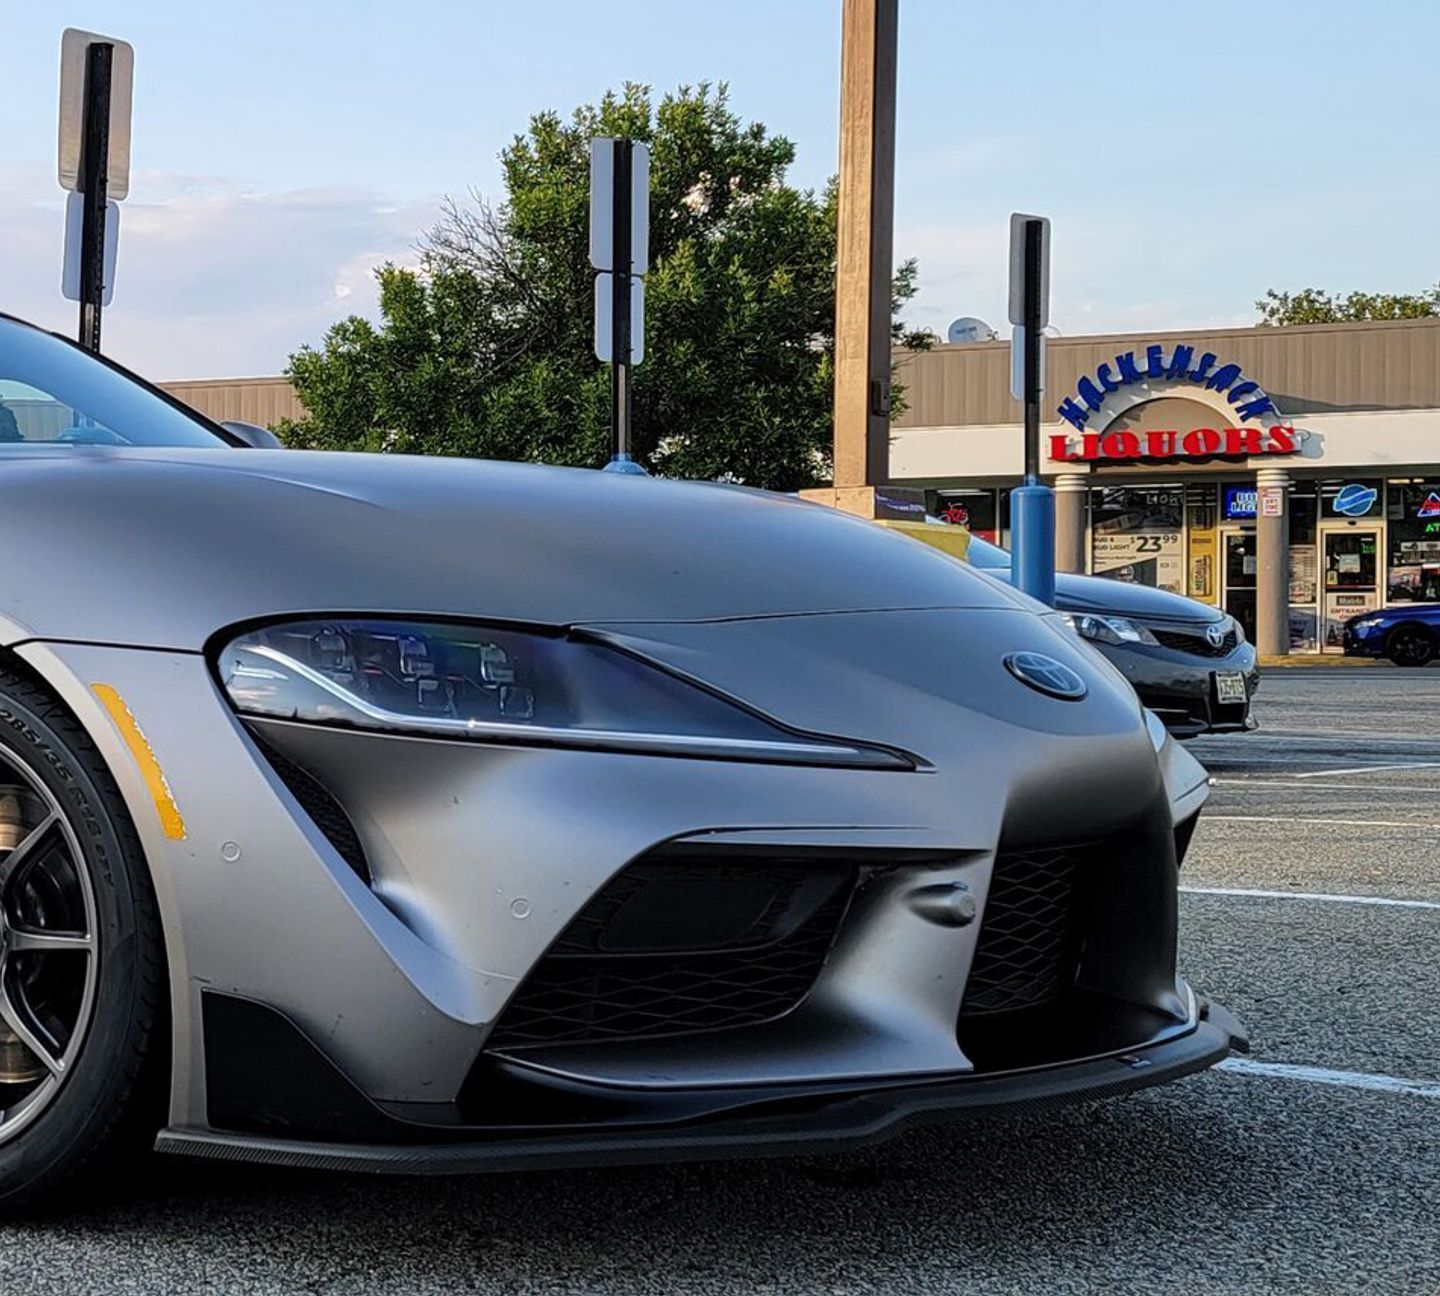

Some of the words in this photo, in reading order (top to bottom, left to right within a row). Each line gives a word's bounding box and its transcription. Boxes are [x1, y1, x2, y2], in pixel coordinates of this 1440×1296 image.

[1057, 345, 1273, 432] HACKENSACK
[1048, 425, 1296, 461] LIQUORS
[1231, 502, 1258, 513] LIG
[1236, 490, 1258, 503] BU
